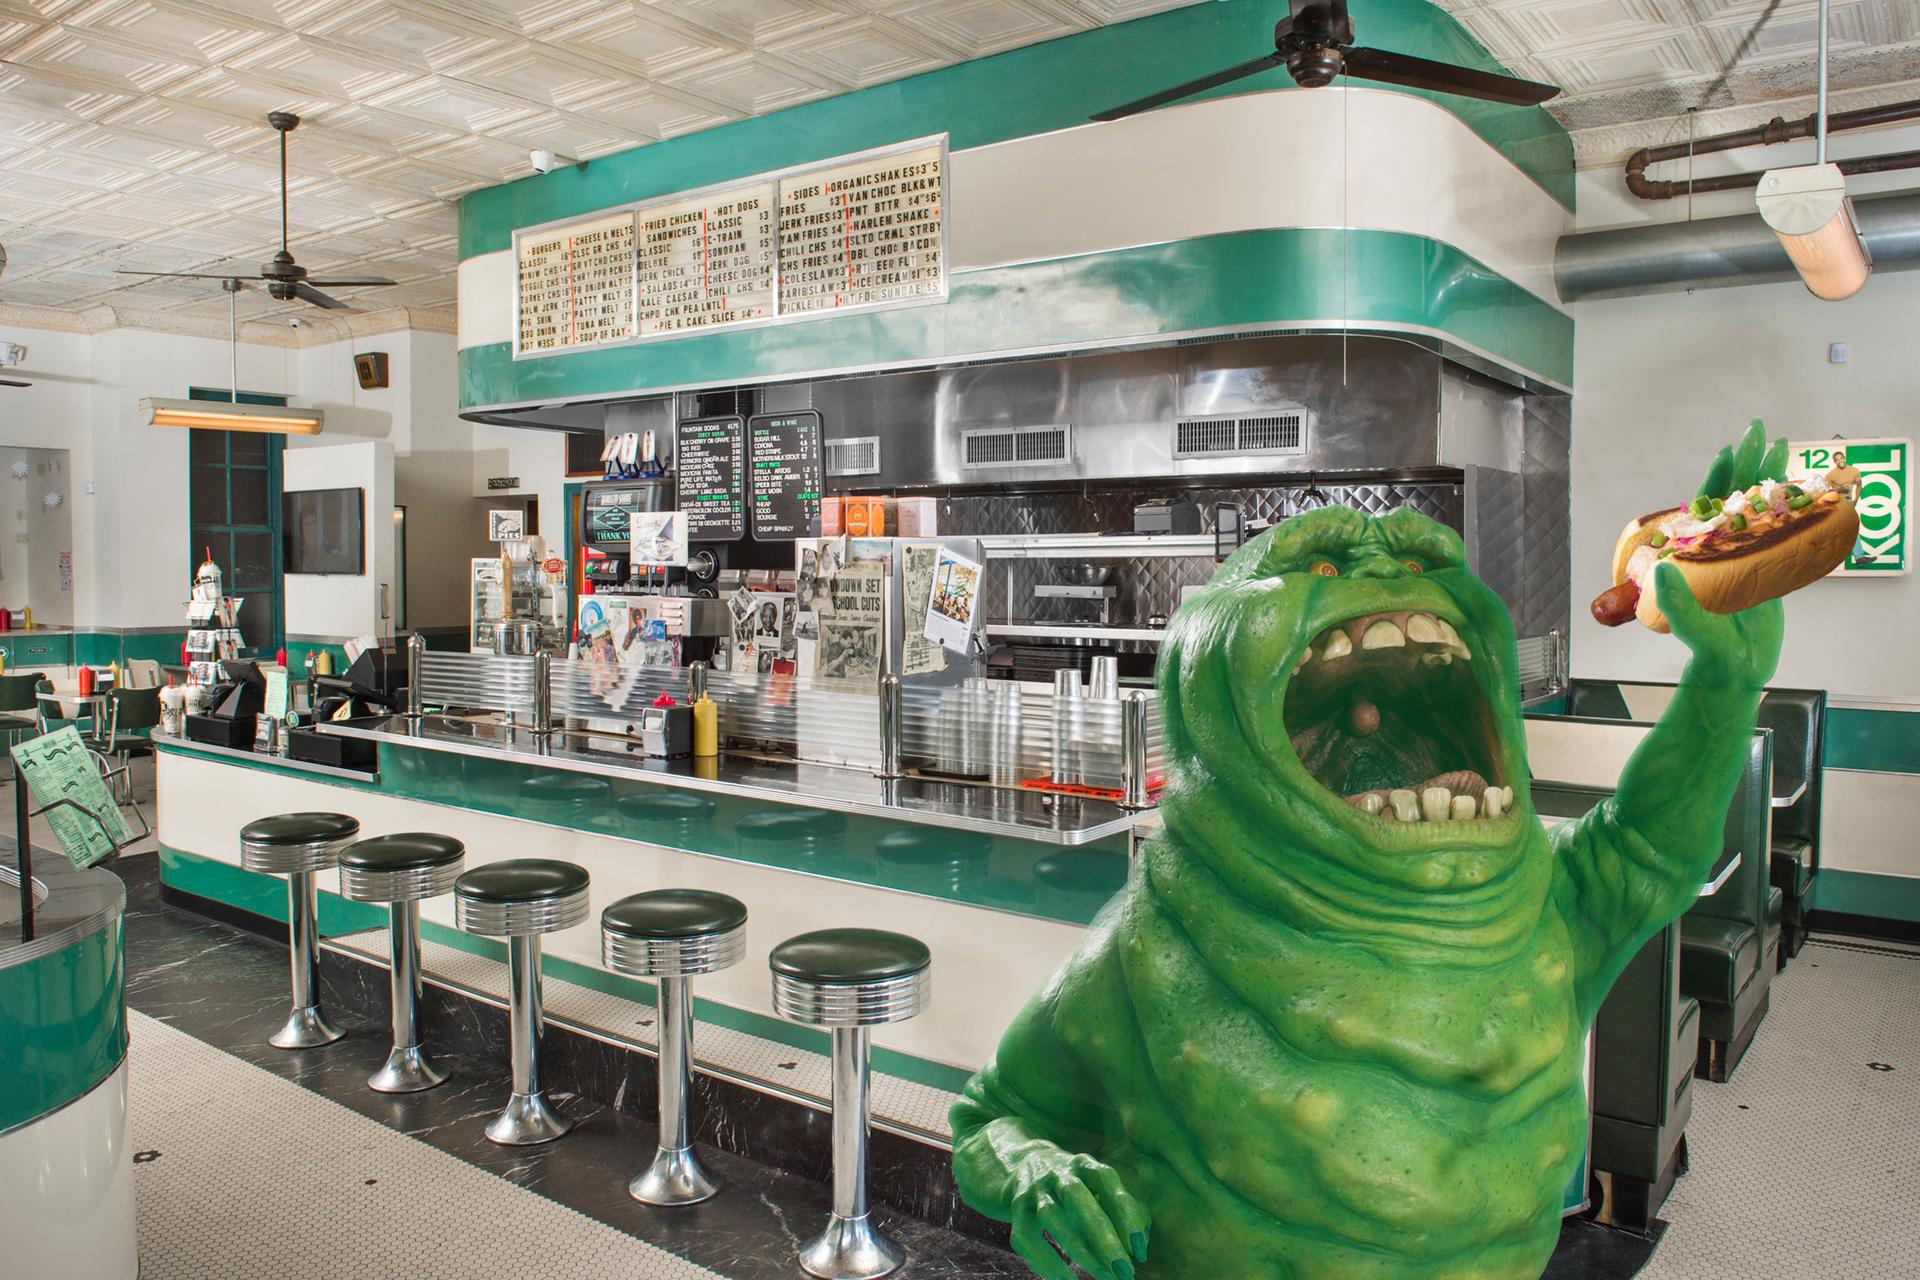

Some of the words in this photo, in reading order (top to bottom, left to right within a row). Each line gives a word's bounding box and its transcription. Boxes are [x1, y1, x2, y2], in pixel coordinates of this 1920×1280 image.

[831, 175, 872, 192] ORGANIC
[794, 185, 819, 200] SIDES
[849, 190, 868, 203] VAN
[871, 184, 896, 199] CHOC
[718, 204, 733, 216] HOT
[738, 199, 759, 212] DOGS
[780, 202, 806, 217] FRIES
[849, 205, 868, 218] PNT
[875, 199, 899, 213] BTTR
[645, 219, 666, 231] FRIED
[670, 211, 702, 226] CHICKEN
[708, 216, 742, 232] CLASSIC
[780, 218, 802, 231] JERK
[805, 212, 830, 226] FRIES
[854, 214, 892, 231] HARLEM
[897, 208, 929, 224] SHAKE
[576, 232, 601, 246] CHEESE
[611, 225, 634, 238] MELTS
[647, 225, 697, 243] SANDWICHES
[708, 230, 742, 245] C-TRAIN
[780, 232, 800, 245] YAM
[803, 226, 828, 241] FRIES
[878, 227, 904, 242] CRML
[532, 241, 561, 256] BURGERS
[606, 241, 619, 252] CHS
[639, 243, 671, 258] CLASSIC
[708, 243, 746, 258] SONORAN
[780, 245, 804, 259] CHILI
[809, 241, 826, 254] CHS
[851, 248, 868, 260] DBL
[875, 243, 897, 257] CHOC
[903, 236, 936, 252] BACON
[520, 256, 547, 270] CLASSIC
[609, 253, 622, 264] CHS
[639, 257, 668, 270] DELUXE
[708, 259, 727, 271] JERK
[734, 255, 750, 267] DOG
[781, 260, 798, 272] CHS
[803, 255, 828, 269] FRIES
[899, 254, 915, 267] FLT
[544, 266, 558, 276] CHS
[640, 271, 658, 282] JERK
[663, 267, 684, 279] CHICK
[708, 270, 738, 284] CHEESE
[742, 267, 757, 278] DOG
[857, 276, 871, 289] ICE
[876, 270, 908, 286] CREAM
[647, 281, 677, 294] SALADS
[737, 282, 753, 293] CHS
[809, 282, 833, 296] SLAW
[882, 282, 921, 300] SUNDAE
[602, 291, 620, 302] MELT
[641, 296, 661, 307] KALE
[667, 291, 698, 304] CAESAR
[602, 303, 618, 314] MELT
[665, 307, 679, 317] CHK
[684, 303, 699, 314] PEA
[782, 300, 811, 314] PICKLE
[598, 316, 615, 327] MELT
[660, 320, 671, 330] PIE
[687, 315, 707, 327] CAKE
[712, 312, 735, 323] SLICE
[580, 332, 597, 342] SOUP
[600, 330, 608, 339] OF
[611, 327, 625, 338] DAY
[1799, 449, 1829, 469] 12
[1851, 448, 1901, 565] KOOL
[597, 532, 621, 541] THANK
[622, 531, 631, 540] YO
[866, 579, 881, 593] SET
[861, 597, 881, 611] CUTS
